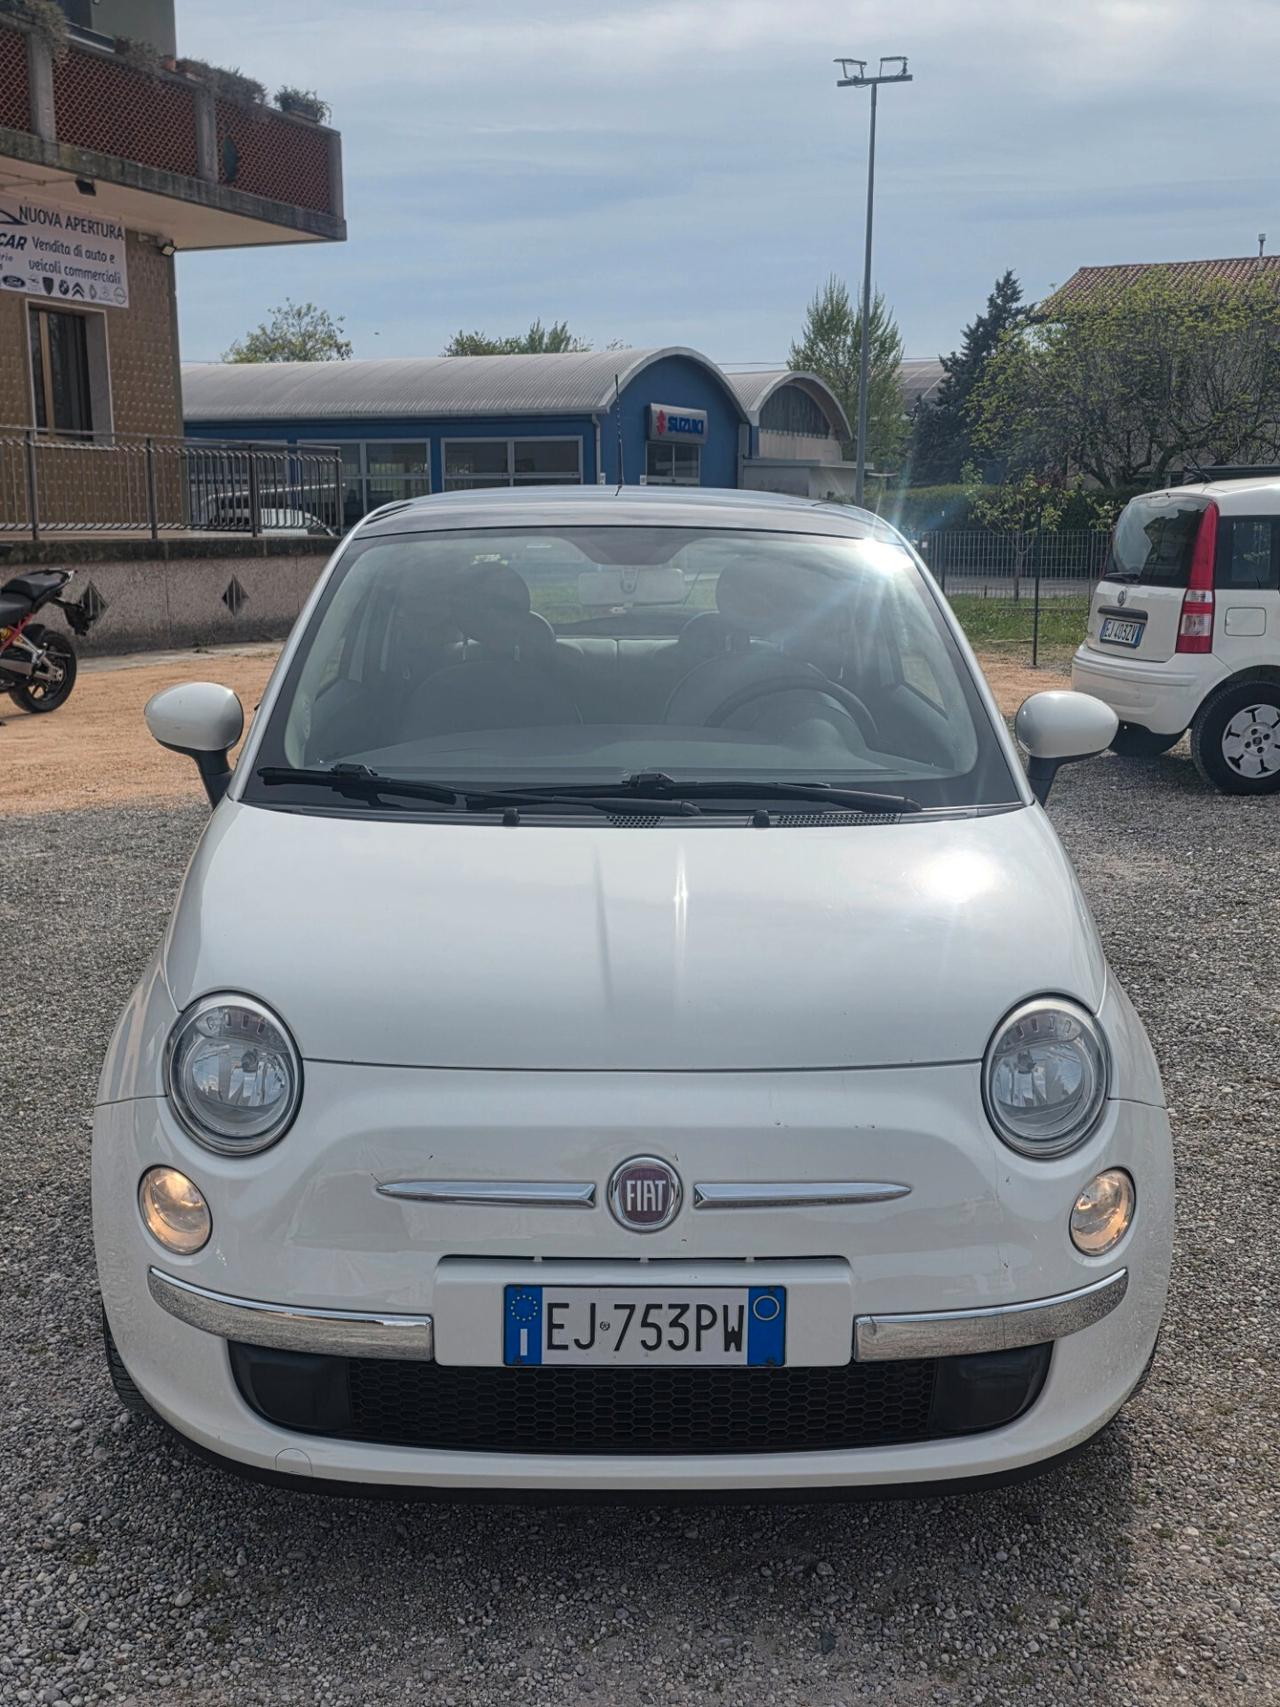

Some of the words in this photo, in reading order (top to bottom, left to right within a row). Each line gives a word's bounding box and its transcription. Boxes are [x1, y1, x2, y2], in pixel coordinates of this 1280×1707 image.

[19, 205, 62, 229] NUOVA
[65, 215, 124, 240] APERTURA
[32, 236, 71, 255] Vendita
[74, 244, 83, 258] di
[85, 248, 107, 263] auto
[109, 253, 115, 264] e
[28, 258, 62, 274] veicoli
[64, 265, 121, 284] commerciali
[668, 416, 704, 434] SUZUKI
[626, 1180, 666, 1211] FIAT
